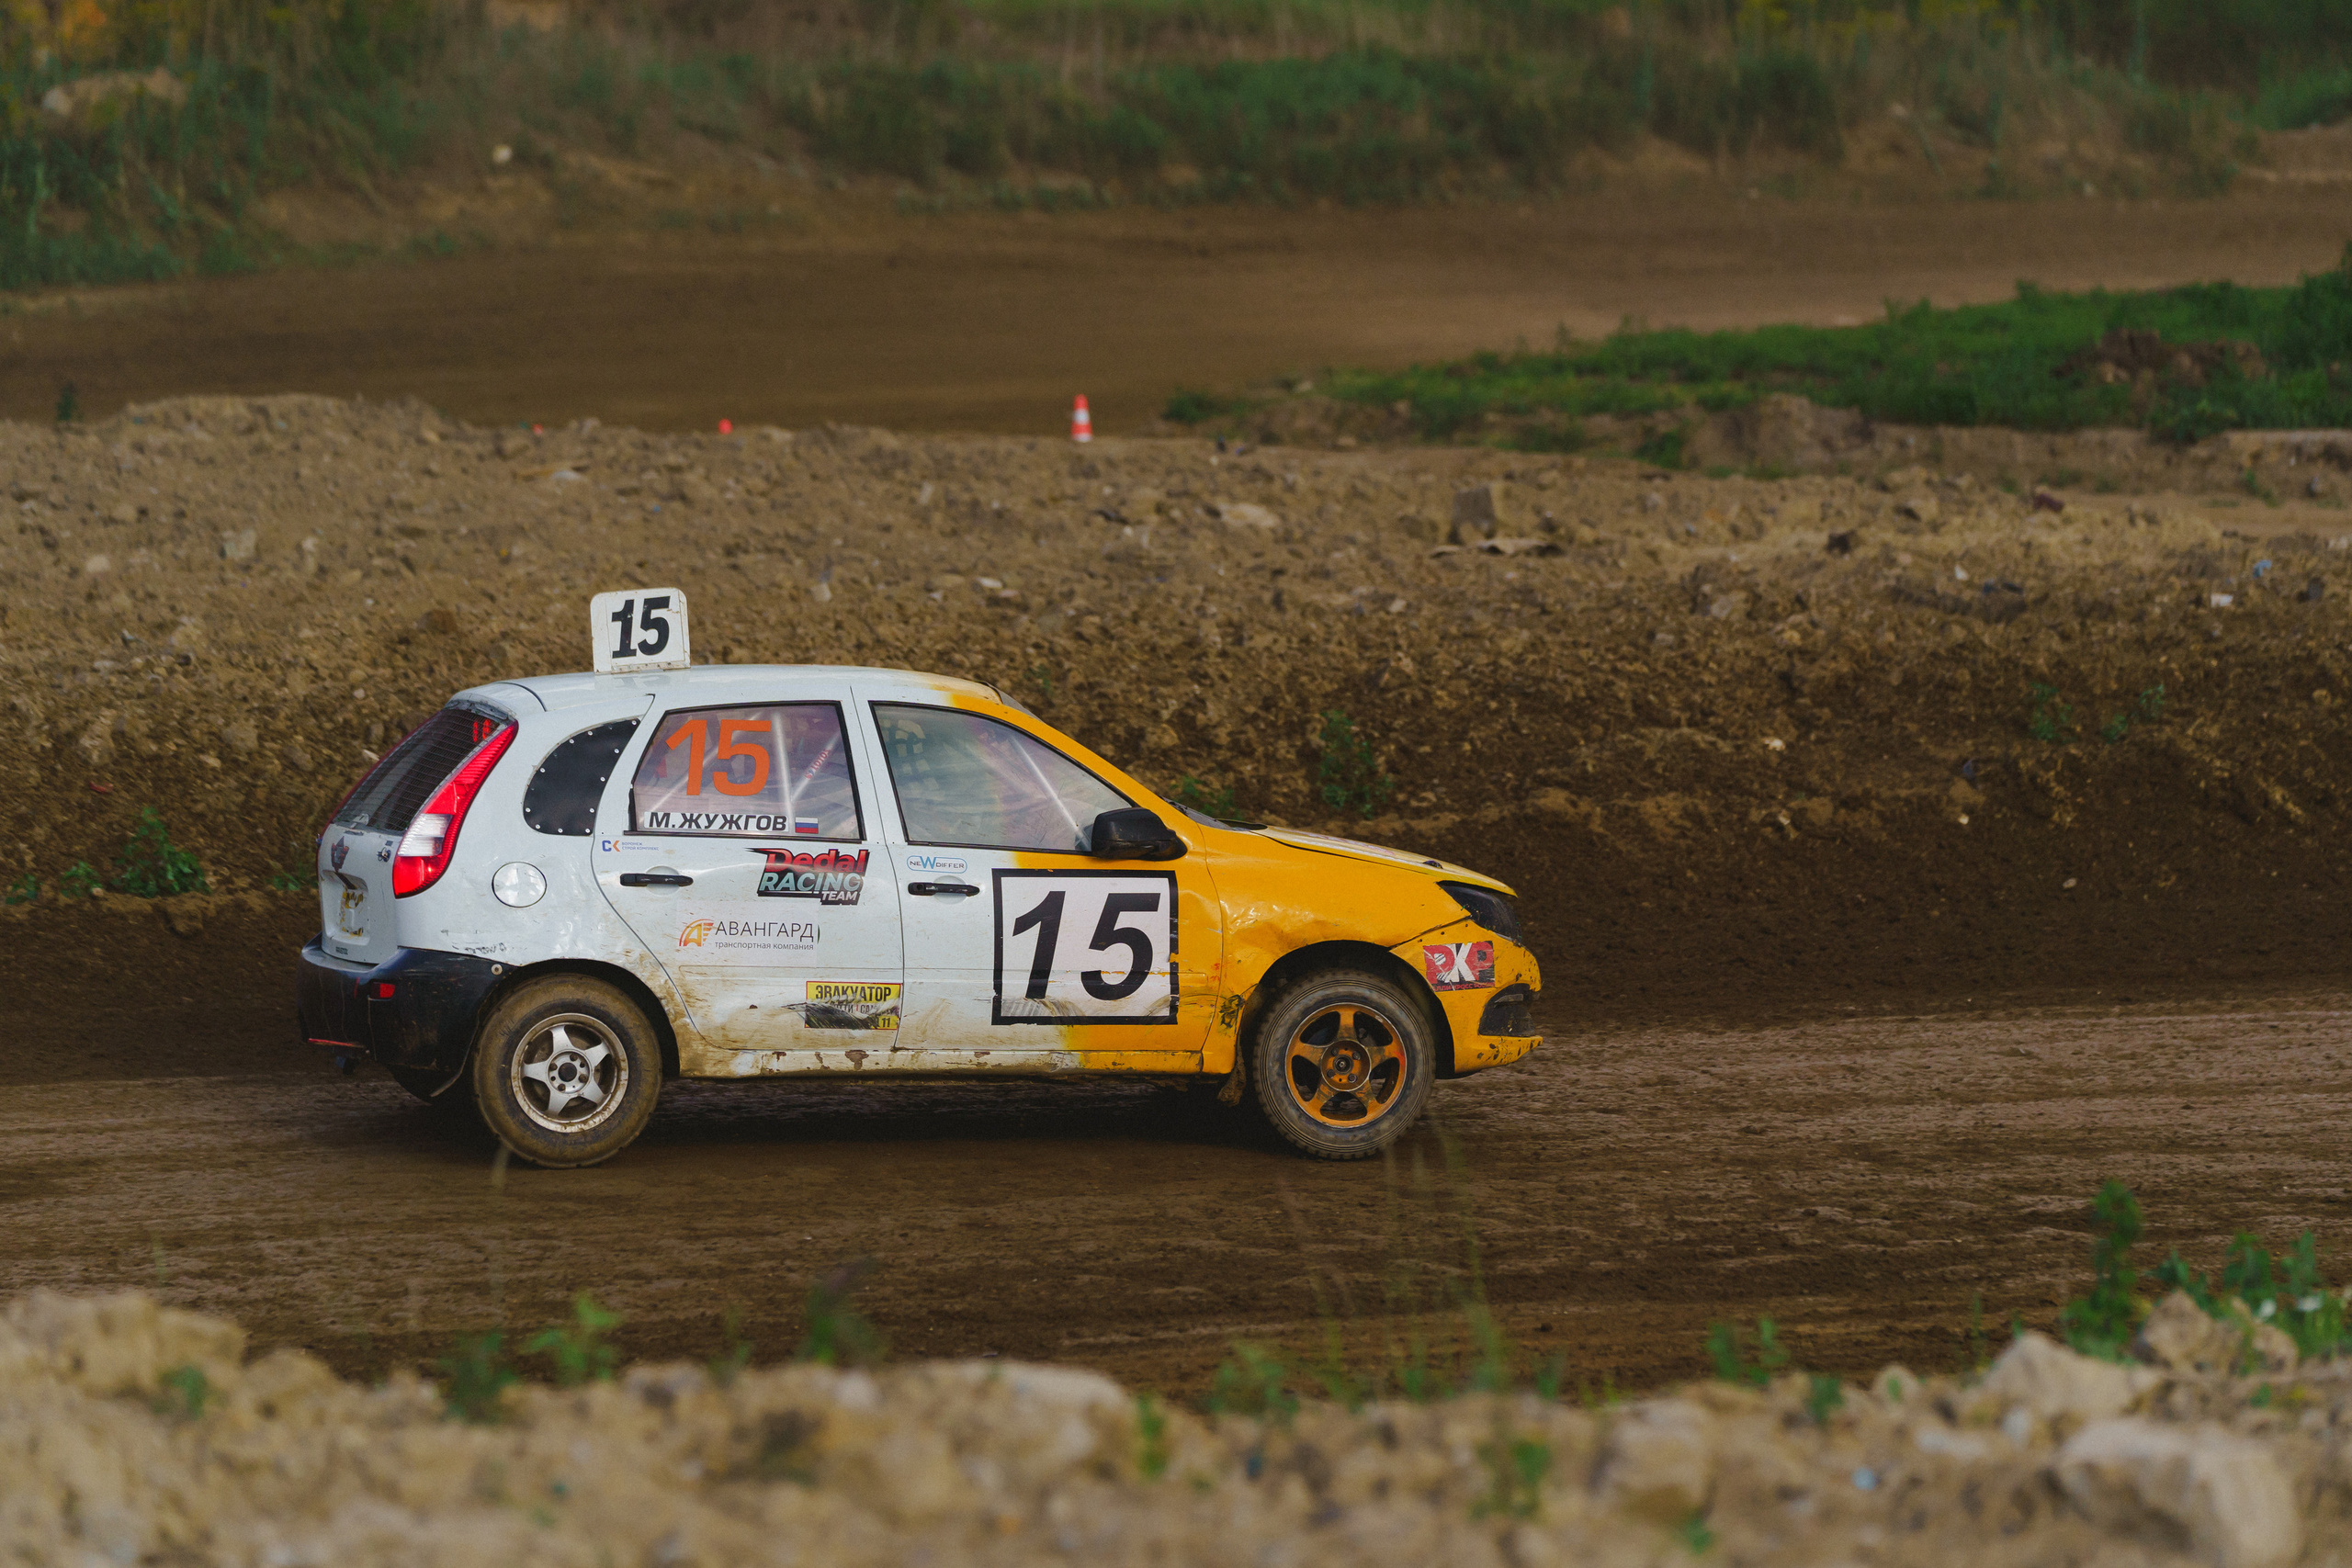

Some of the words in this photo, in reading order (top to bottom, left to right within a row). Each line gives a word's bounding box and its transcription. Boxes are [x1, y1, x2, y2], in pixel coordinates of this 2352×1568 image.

[611, 595, 671, 659] 15
[665, 718, 772, 796] 15
[758, 872, 862, 892] RACING
[821, 891, 858, 901] TEAM
[715, 920, 814, 942] АВАНГАРД
[715, 942, 772, 950] транспортная
[1012, 890, 1161, 1001] 15
[815, 985, 891, 1002] ЭВАКУАТОР
